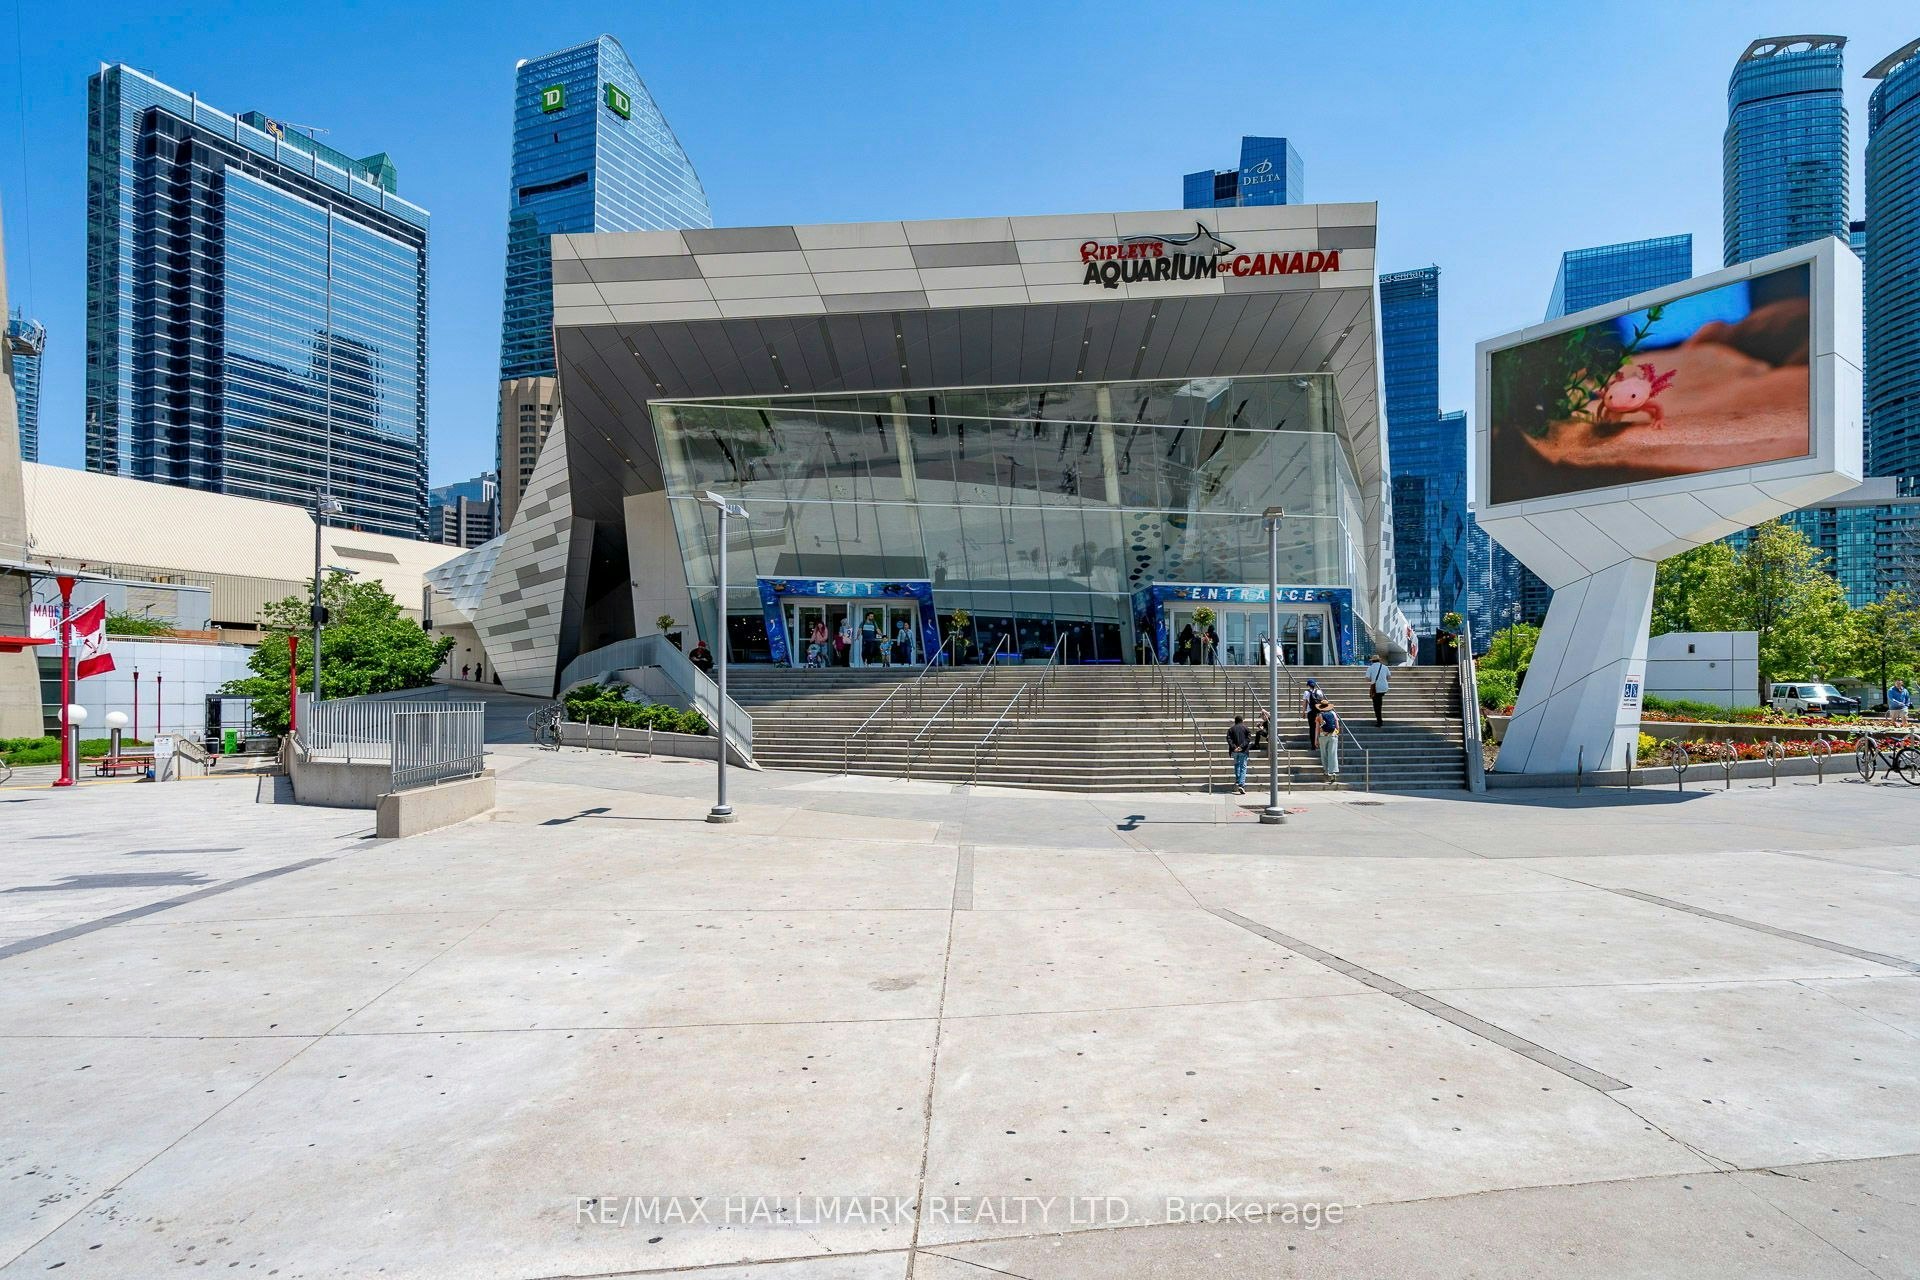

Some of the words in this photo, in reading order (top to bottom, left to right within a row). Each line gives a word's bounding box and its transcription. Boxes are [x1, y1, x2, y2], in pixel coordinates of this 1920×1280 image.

[544, 89, 560, 106] TD
[612, 89, 629, 112] TD
[1243, 173, 1281, 186] DELTA
[1080, 241, 1164, 265] RIPLEY'S
[1082, 253, 1217, 290] AQUARIUM
[1217, 261, 1233, 273] OF
[1232, 250, 1341, 277] CANADA
[816, 582, 875, 595] EXIT
[1191, 587, 1315, 602] ENTRANCE
[33, 604, 59, 618] MADE
